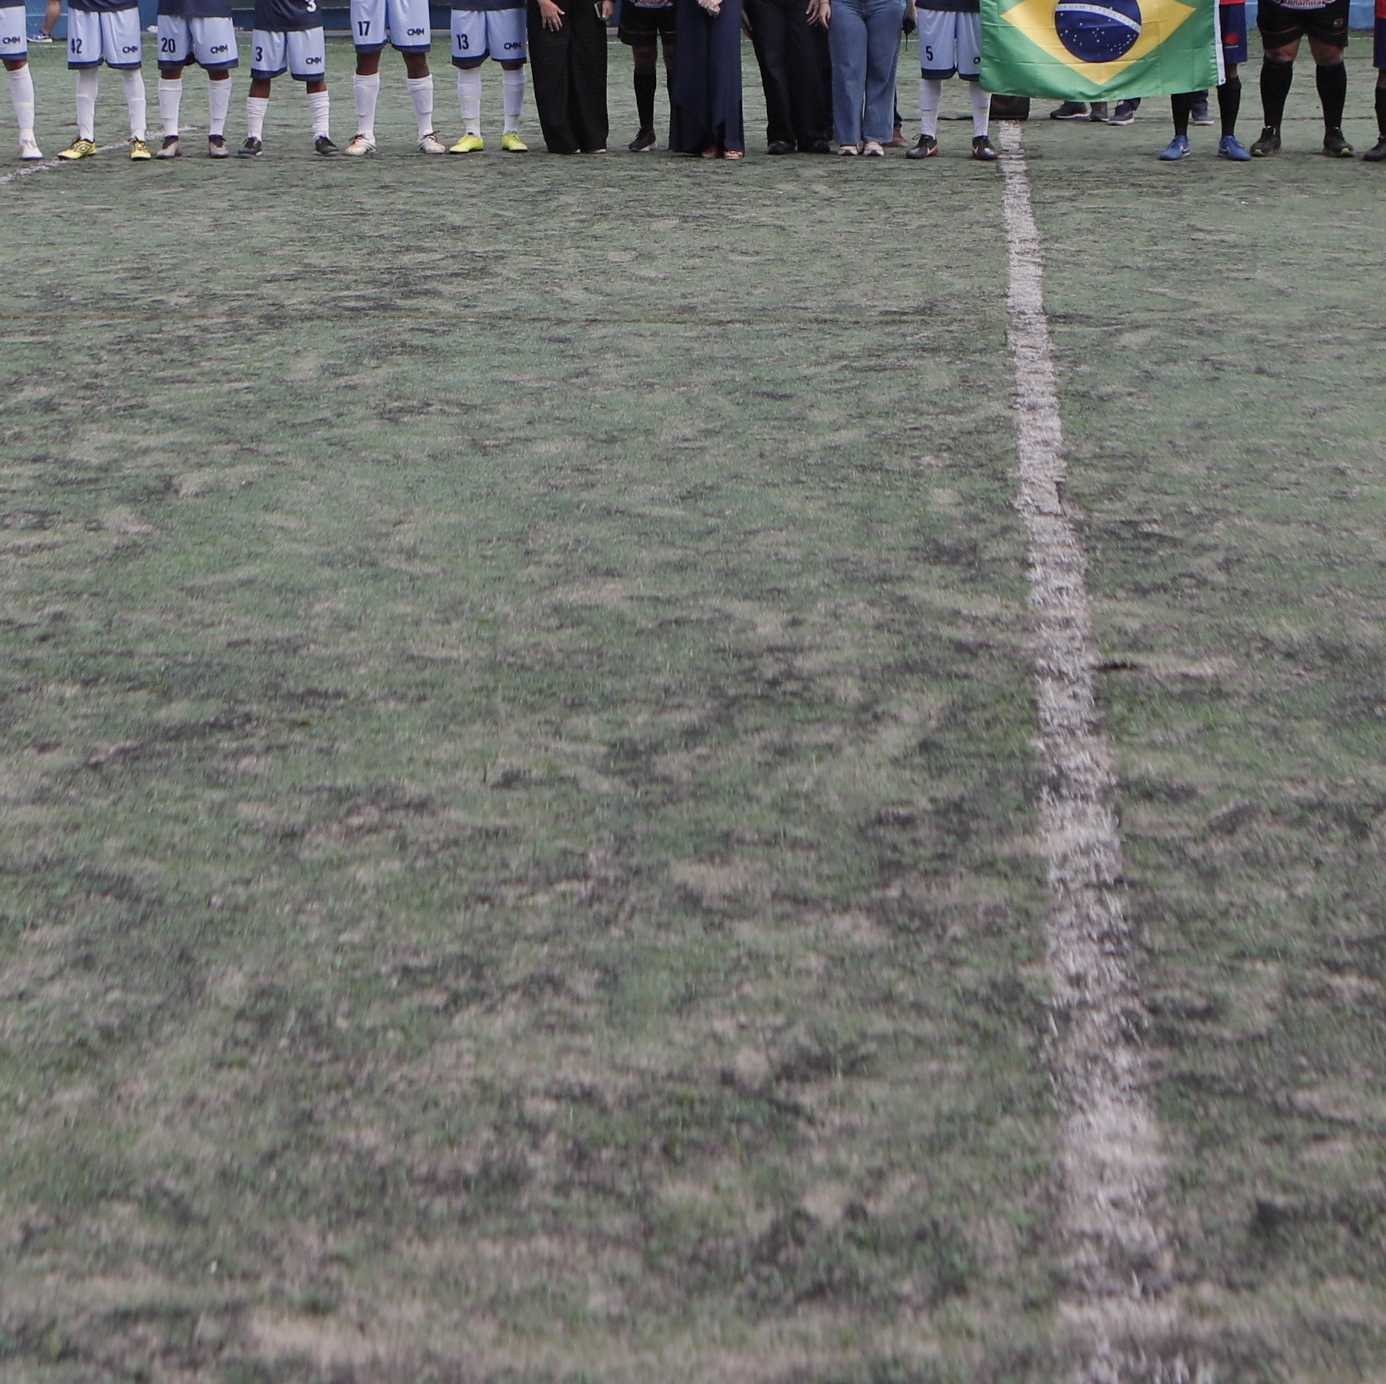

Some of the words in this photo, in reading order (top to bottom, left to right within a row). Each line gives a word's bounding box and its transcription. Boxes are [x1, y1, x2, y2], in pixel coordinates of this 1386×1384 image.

[358, 21, 370, 36] 17
[407, 28, 424, 36] CMM
[2, 36, 21, 45] CMM
[71, 38, 82, 54] 42
[161, 38, 176, 53] 20
[457, 34, 469, 50] 13
[504, 42, 522, 50] CMM
[122, 46, 138, 54] CMM
[210, 44, 228, 54] CMM
[256, 46, 263, 62] 3
[926, 46, 933, 61] 5
[305, 56, 322, 65] CMM
